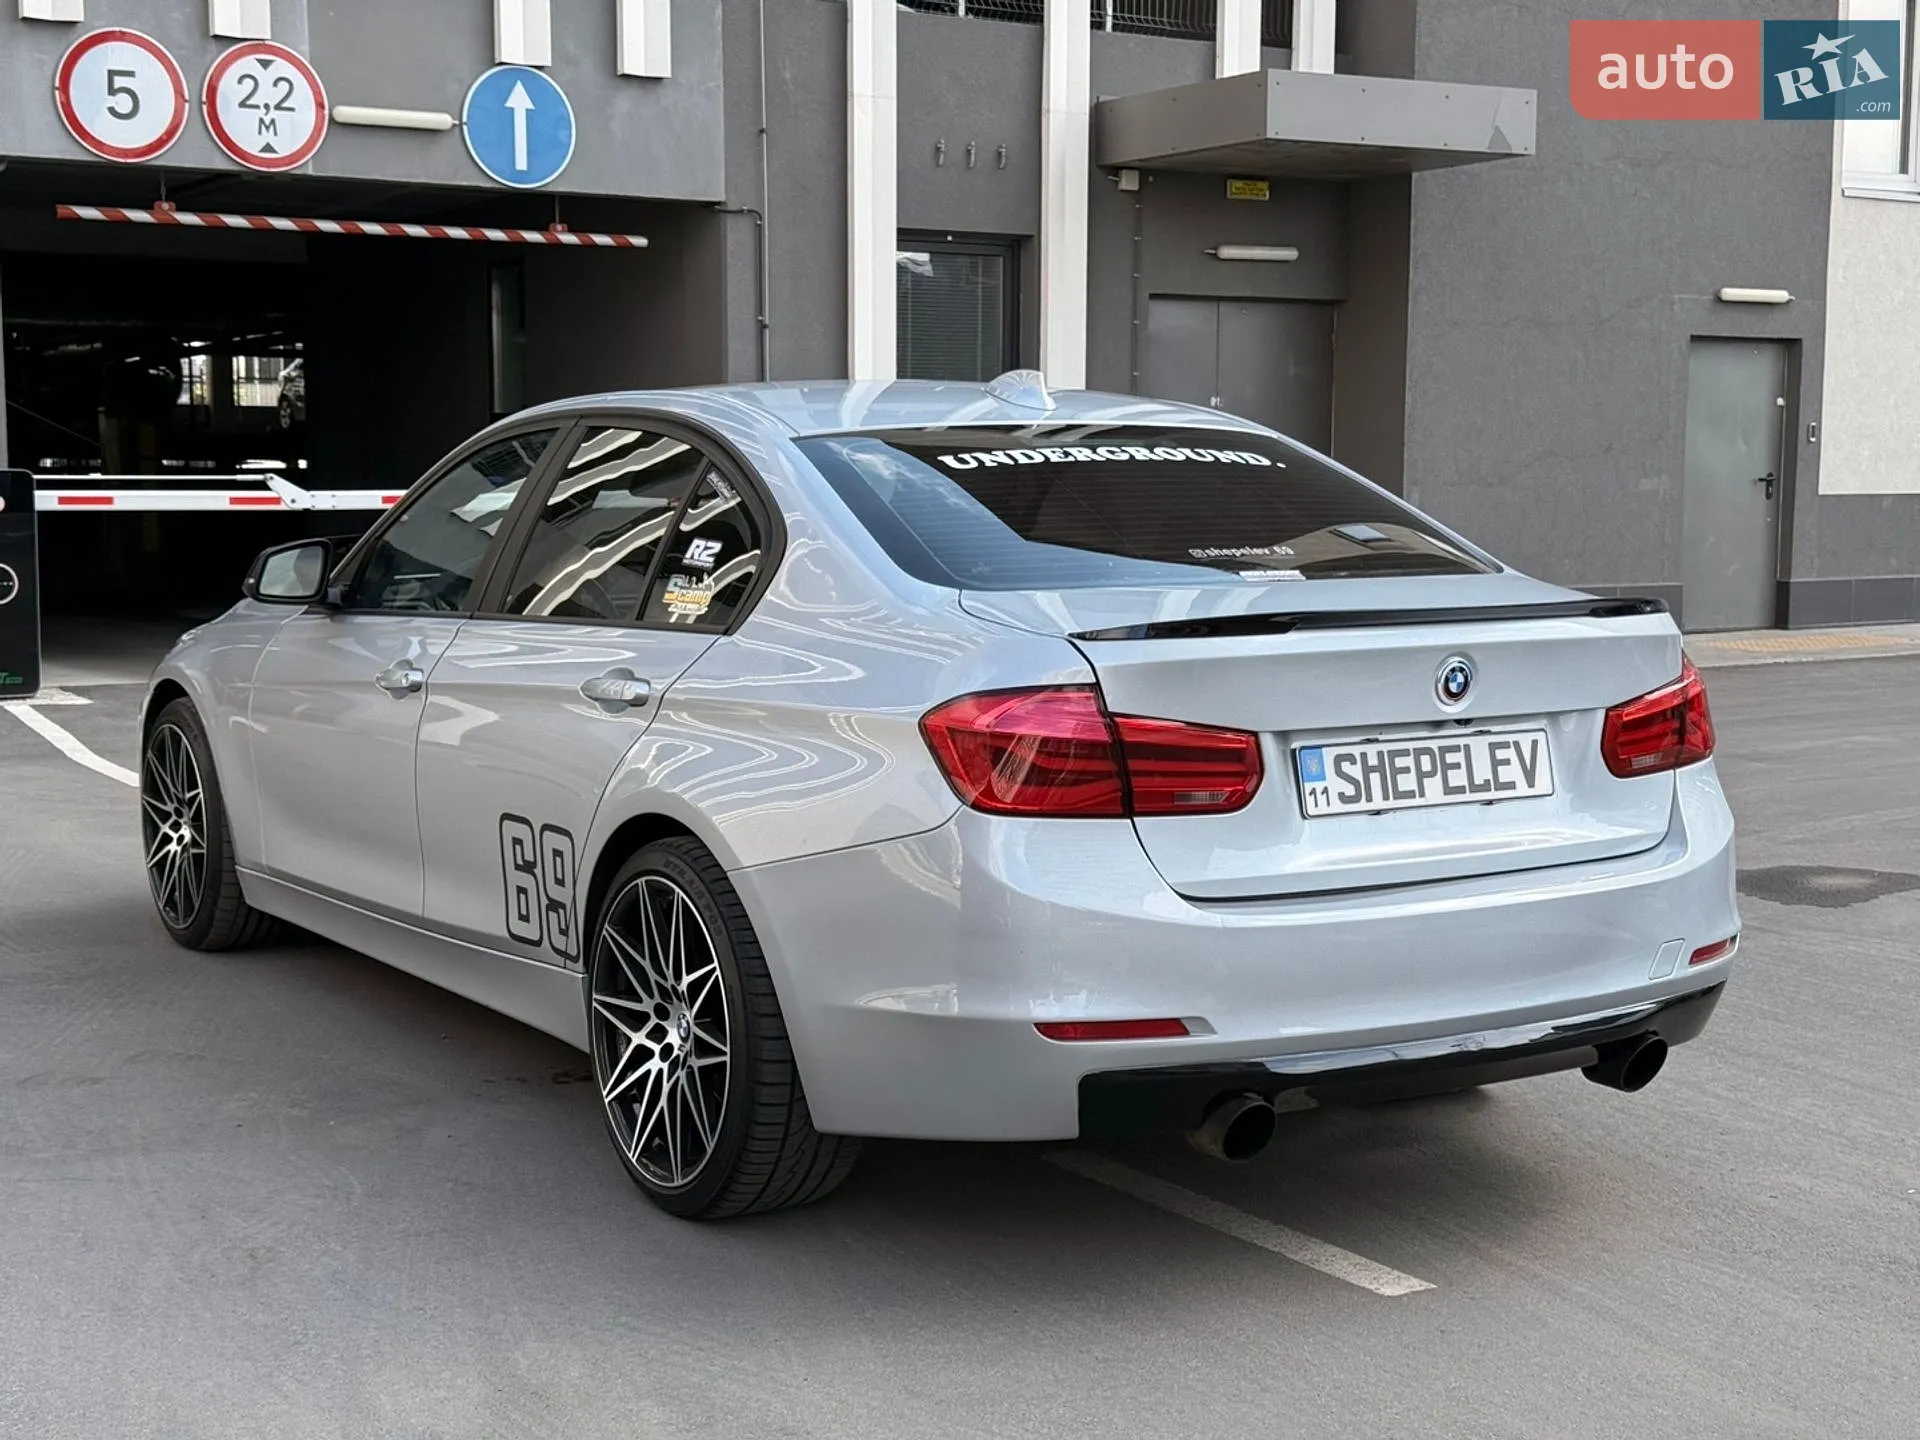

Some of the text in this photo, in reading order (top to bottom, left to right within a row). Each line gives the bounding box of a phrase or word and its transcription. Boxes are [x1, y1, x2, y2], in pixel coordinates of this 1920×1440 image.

[106, 68, 141, 121] 5
[236, 72, 296, 115] 2,2
[937, 446, 1288, 470] UNDERGROUND.
[684, 538, 724, 563] R2
[1333, 738, 1539, 804] SHEPELEV
[1308, 785, 1331, 809] 11
[499, 812, 581, 964] 69
